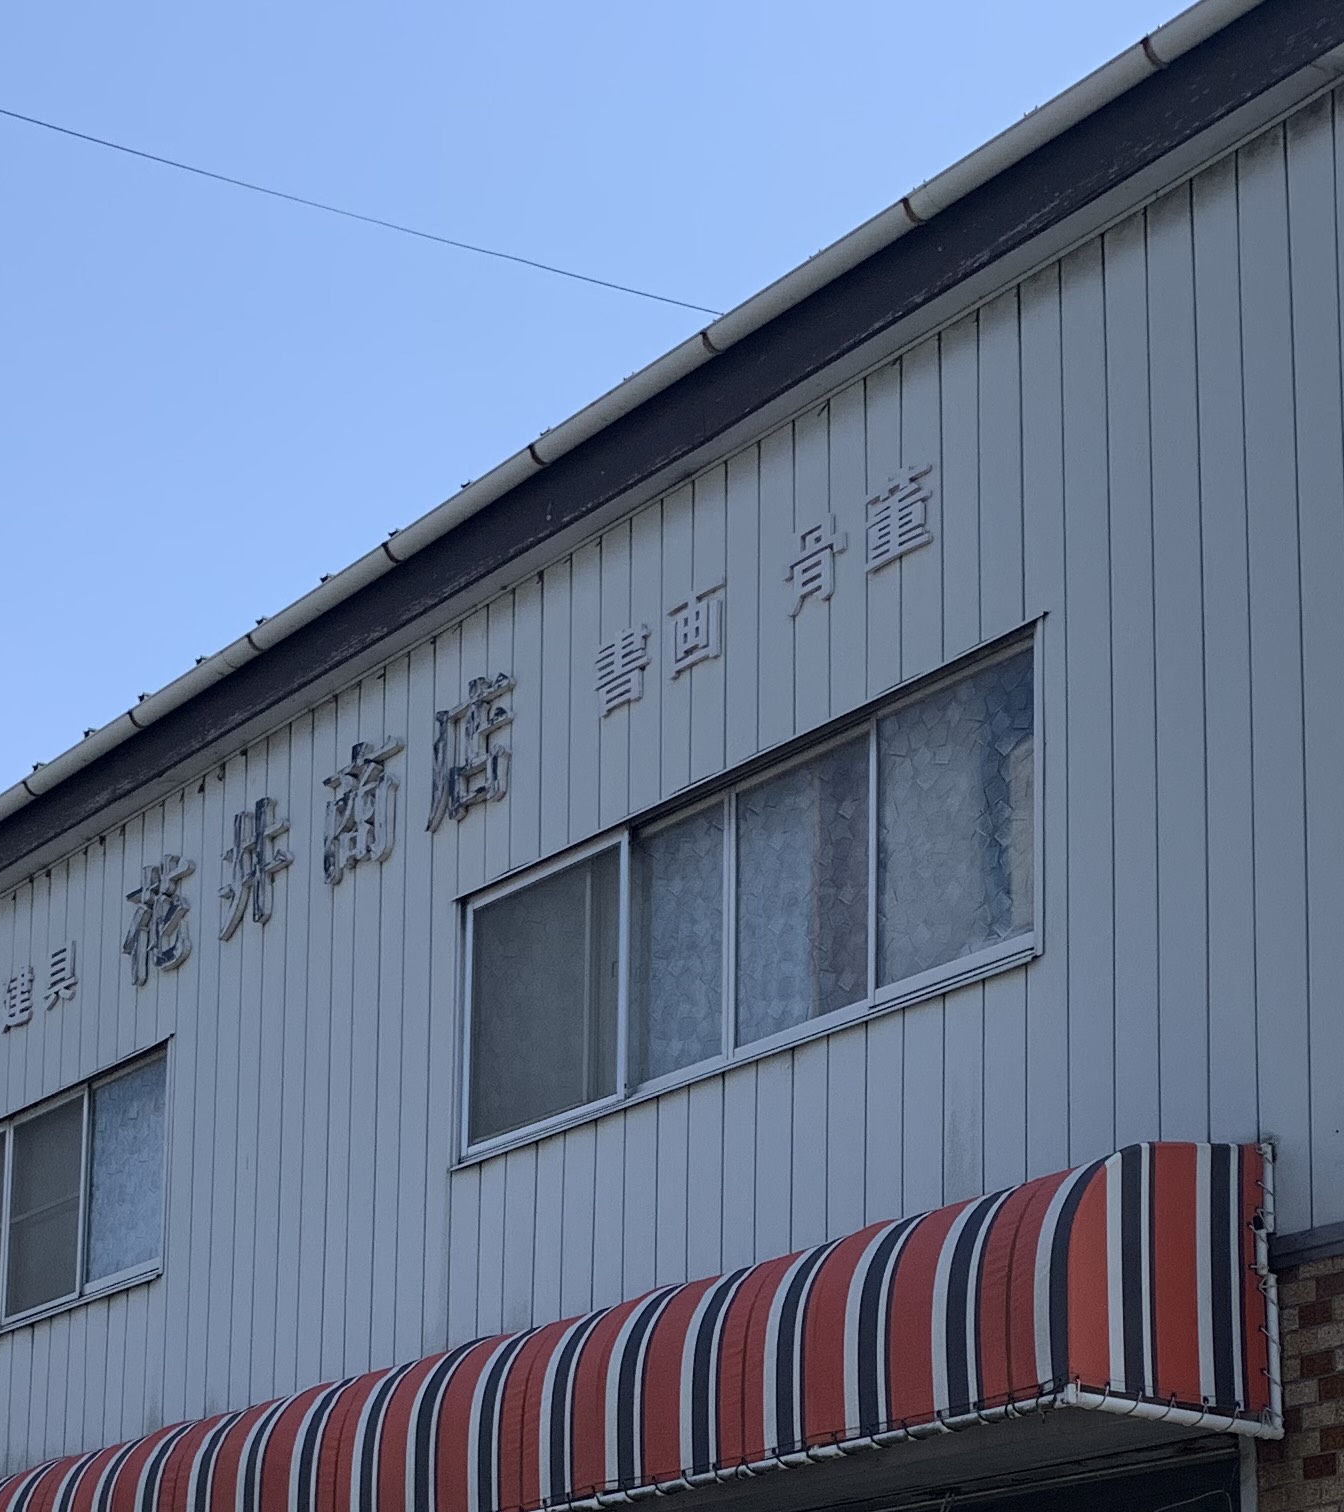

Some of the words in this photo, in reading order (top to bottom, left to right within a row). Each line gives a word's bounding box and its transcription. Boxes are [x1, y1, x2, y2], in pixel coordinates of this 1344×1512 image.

[594, 576, 728, 718] 書画
[783, 463, 934, 620] 骨董
[122, 671, 516, 987] 花井商店
